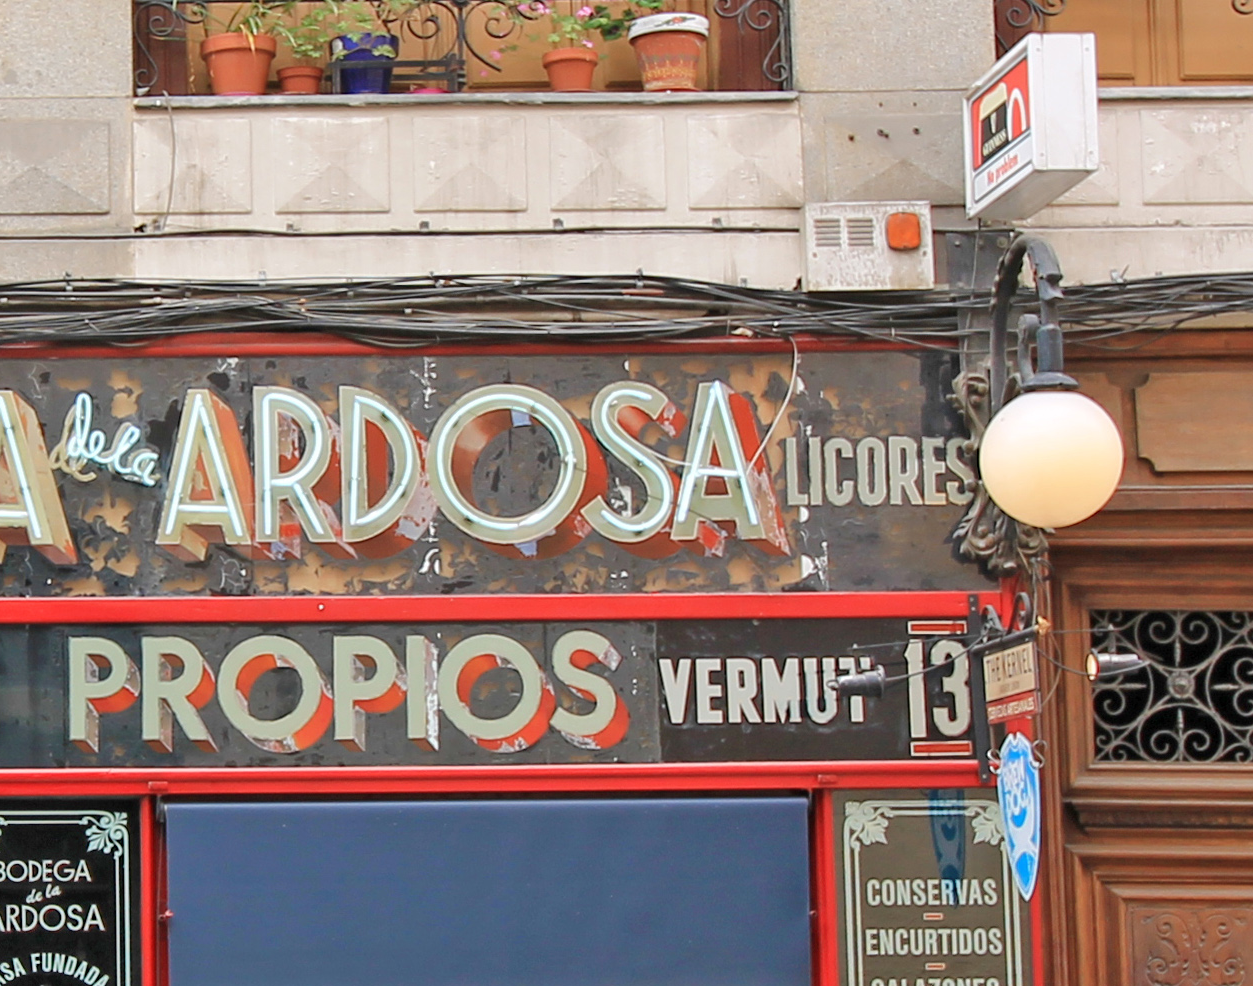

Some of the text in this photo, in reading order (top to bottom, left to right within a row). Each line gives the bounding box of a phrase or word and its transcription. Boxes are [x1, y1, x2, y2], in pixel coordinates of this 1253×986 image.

[105, 419, 162, 488] la
[155, 380, 767, 545] ARDOSA
[786, 436, 975, 507] LICORES
[68, 629, 621, 745] PROPIOS
[658, 637, 971, 739] VERMUT 13
[986, 646, 1033, 685] THE KERNEL
[25, 883, 62, 904] de la
[866, 878, 998, 906] CONSERVAS
[865, 928, 1003, 956] ENCURTIDOS
